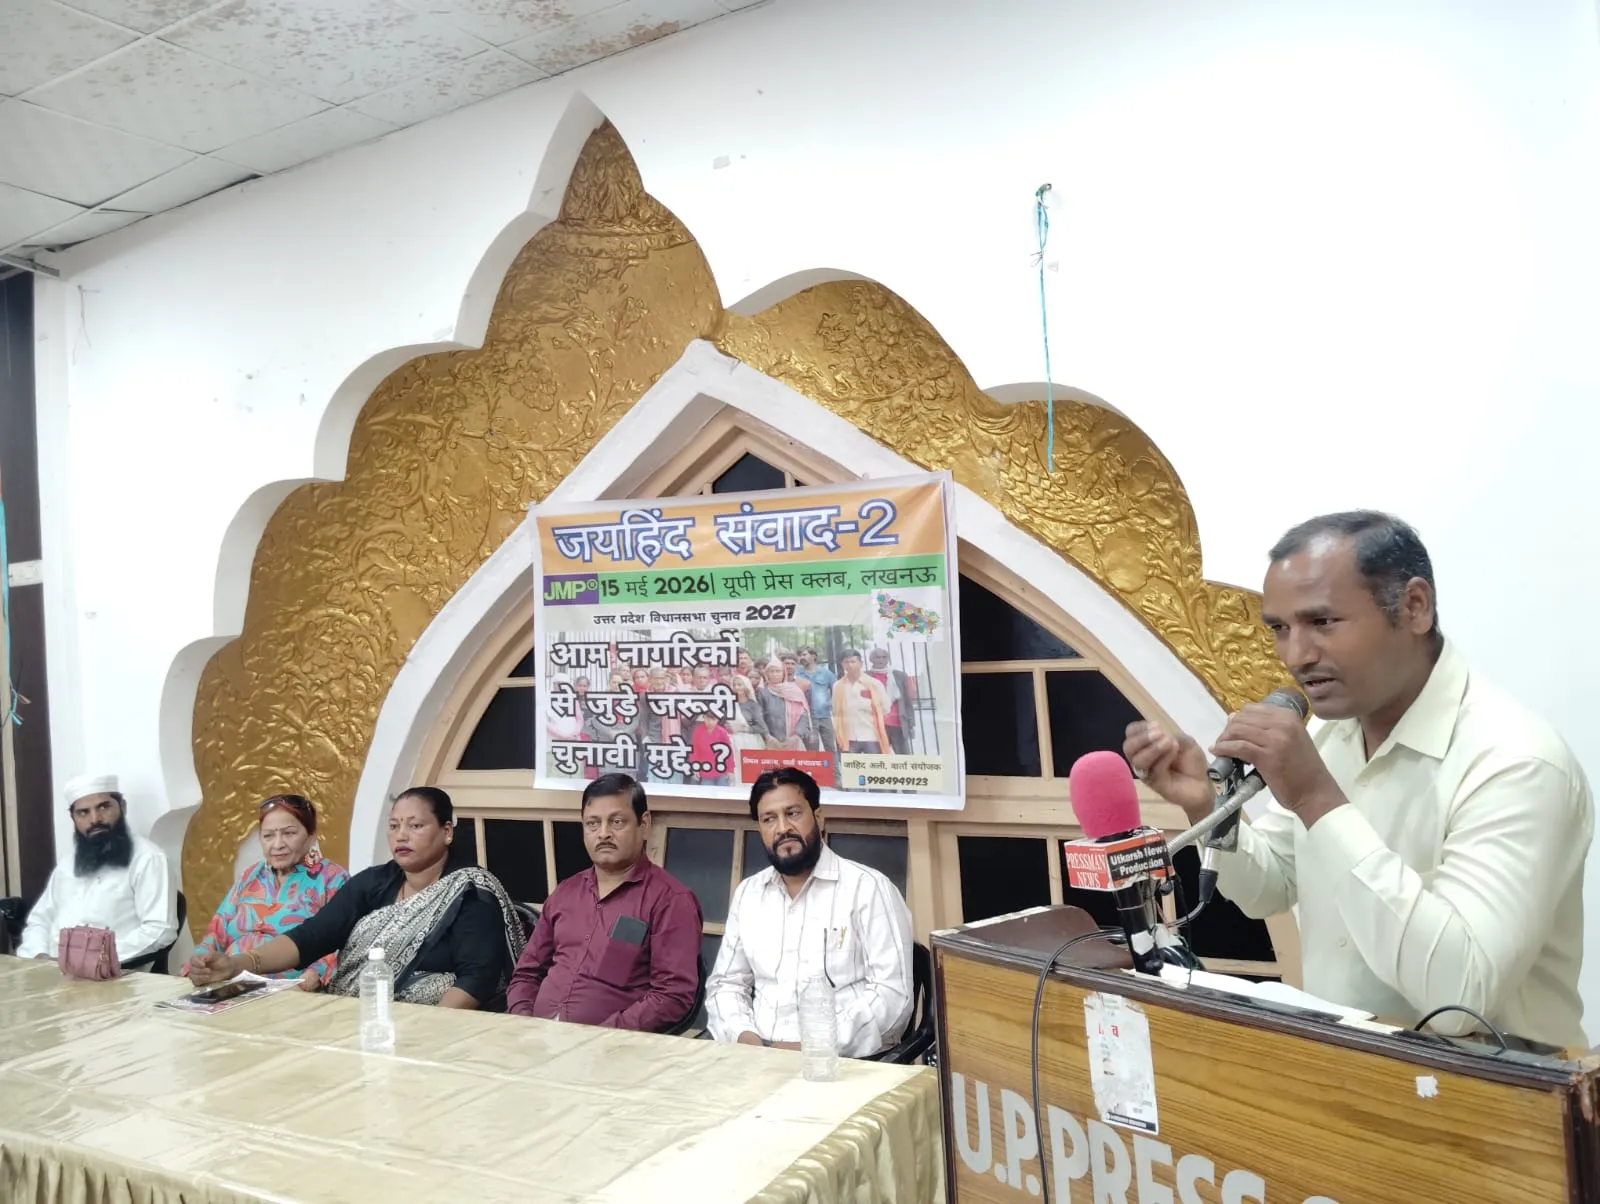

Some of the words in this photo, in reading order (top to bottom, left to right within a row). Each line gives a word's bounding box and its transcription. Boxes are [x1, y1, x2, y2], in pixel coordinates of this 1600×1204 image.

[552, 508, 695, 567] जयहिंद
[714, 498, 899, 555] संवाद-2
[601, 579, 620, 596] 15
[625, 575, 648, 597] मई
[722, 570, 756, 597] यूपी
[762, 569, 794, 592] प्रेस
[800, 571, 852, 590] क्लब,
[860, 566, 938, 586] लखनऊ
[594, 614, 616, 626] उत्तर
[620, 613, 645, 625] प्रदेश
[650, 610, 706, 625] विधानसभा
[711, 611, 741, 625] चुनाव
[745, 604, 796, 621] 2027
[550, 642, 610, 668] आम
[616, 630, 741, 668] नागरिकों
[550, 683, 577, 717] से
[586, 683, 640, 726] जुड़े
[648, 683, 737, 720] जरूरी
[551, 733, 637, 774] चुनावी
[867, 776, 929, 786] 9984949123
[1066, 853, 1106, 870] PRESSMAN
[1110, 849, 1144, 865] Utkarsh
[1077, 872, 1101, 888] NEWS
